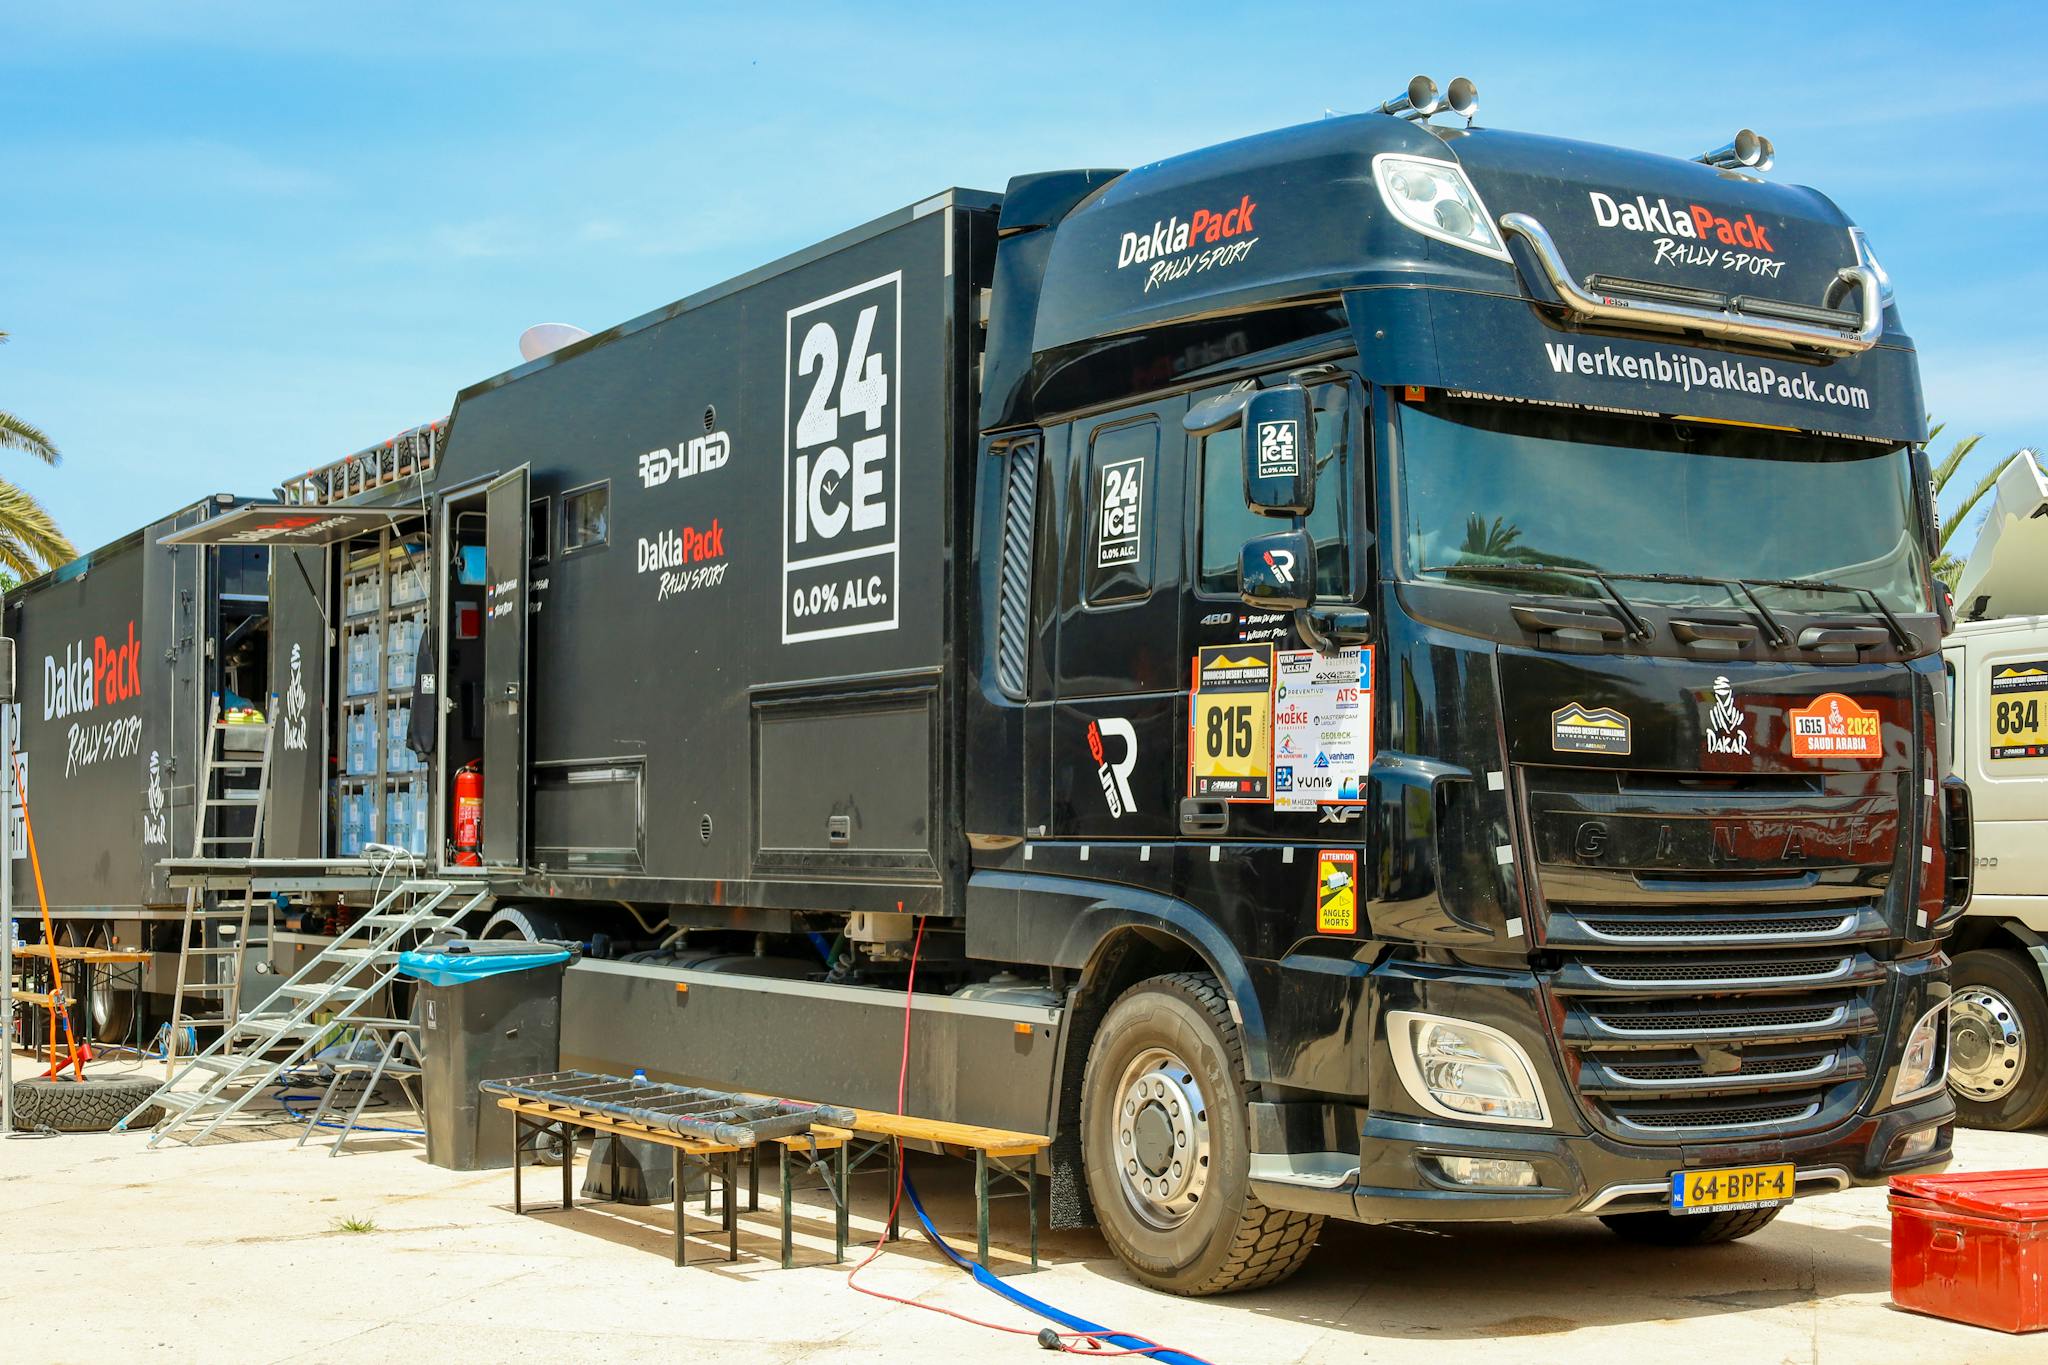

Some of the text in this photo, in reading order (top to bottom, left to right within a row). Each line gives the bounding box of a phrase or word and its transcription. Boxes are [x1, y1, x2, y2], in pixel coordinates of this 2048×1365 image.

[1118, 195, 1257, 270] DaklaPack
[1589, 191, 1774, 253] DaklaPack
[1144, 237, 1259, 293] RALLY SPORT
[1653, 237, 1786, 279] RALLY SPORT
[796, 305, 888, 450] 24
[1545, 343, 1870, 410] WerkenbijDaklaPack.com
[1262, 424, 1294, 447] 24
[1262, 444, 1294, 462] ICE
[795, 434, 887, 544] ICE
[1104, 466, 1138, 508] 24
[1103, 504, 1137, 538] ICE
[637, 518, 724, 573] DaklaPack
[1102, 545, 1136, 560] 0.0% ALC.
[658, 563, 728, 601] RALLY SPORT
[793, 575, 887, 617] 0.0% ALC.
[1200, 612, 1232, 625] 480
[44, 619, 141, 721] DaklaPack
[1336, 688, 1358, 701] ATS
[1206, 705, 1252, 758] 815
[1276, 712, 1308, 725] MOEKE
[1799, 718, 1823, 734] 1615
[1847, 717, 1876, 736] 2023
[1997, 700, 2039, 735] 834
[1706, 728, 1750, 755] DAKAR
[1807, 737, 1867, 751] SAUDI ARABIA
[1318, 805, 1365, 824] XF
[1321, 853, 1354, 861] ATTENTION
[1323, 909, 1350, 918] ANGLES
[1324, 918, 1349, 927] MORTS
[1674, 1193, 1683, 1202] NL
[1692, 1170, 1785, 1201] 64-BPF-4
[1688, 1205, 1710, 1215] BAKKER
[1759, 1199, 1779, 1209] GROEP
